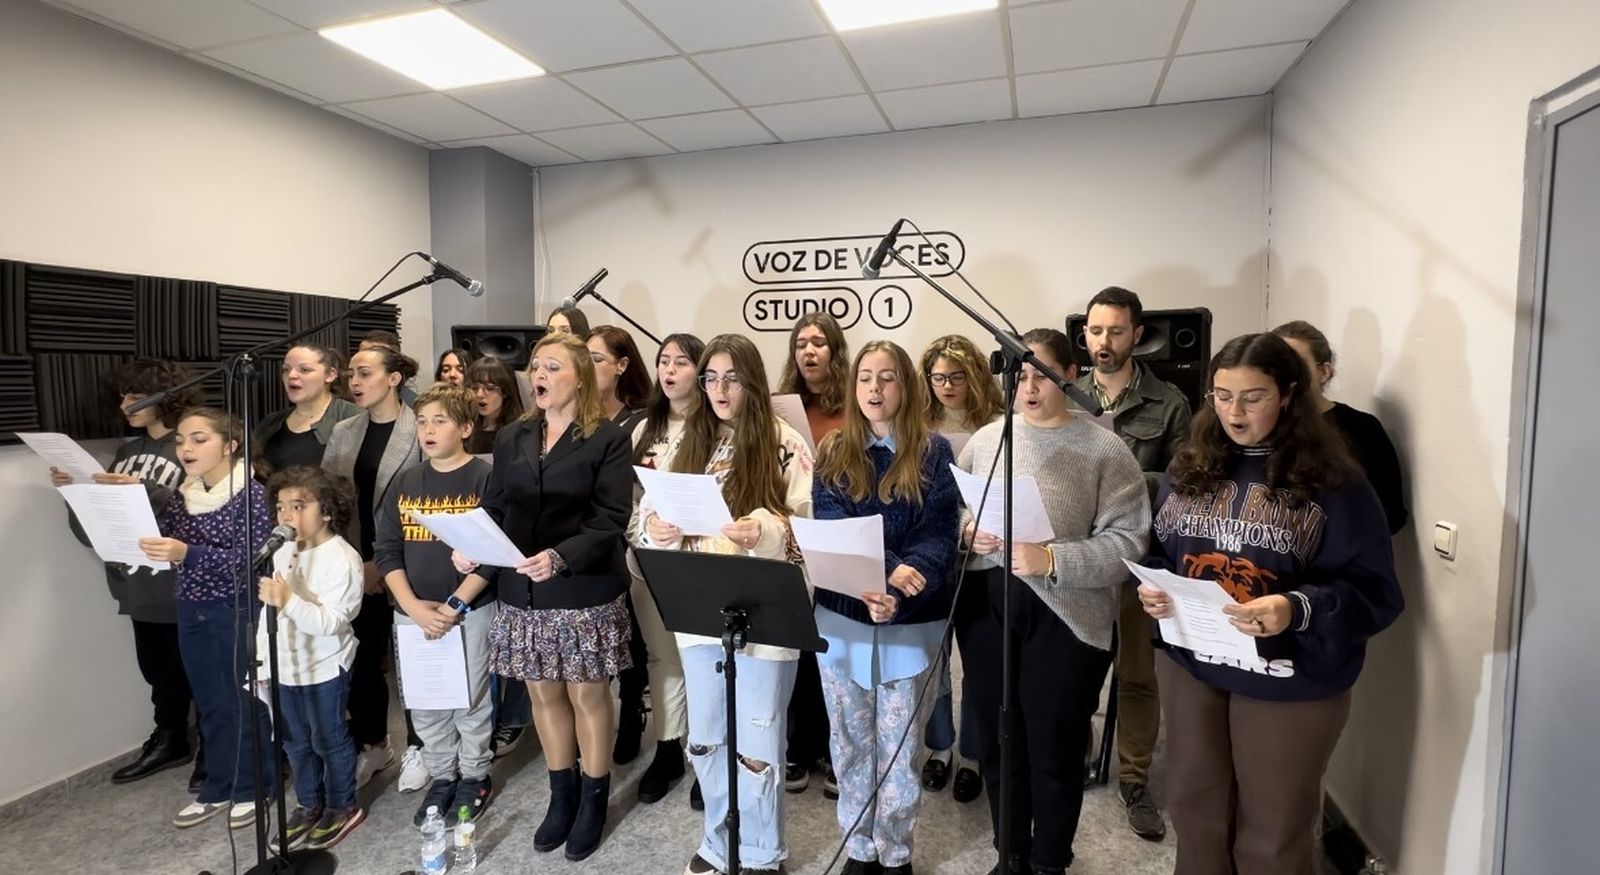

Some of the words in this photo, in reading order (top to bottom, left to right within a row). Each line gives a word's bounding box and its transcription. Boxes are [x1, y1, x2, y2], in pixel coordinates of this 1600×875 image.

[753, 250, 807, 274] VOZ
[815, 248, 848, 270] DE
[754, 297, 849, 321] STUDIO
[883, 297, 893, 318] 1
[1177, 513, 1293, 554] CHAMPIONS
[1215, 533, 1242, 552] 1986
